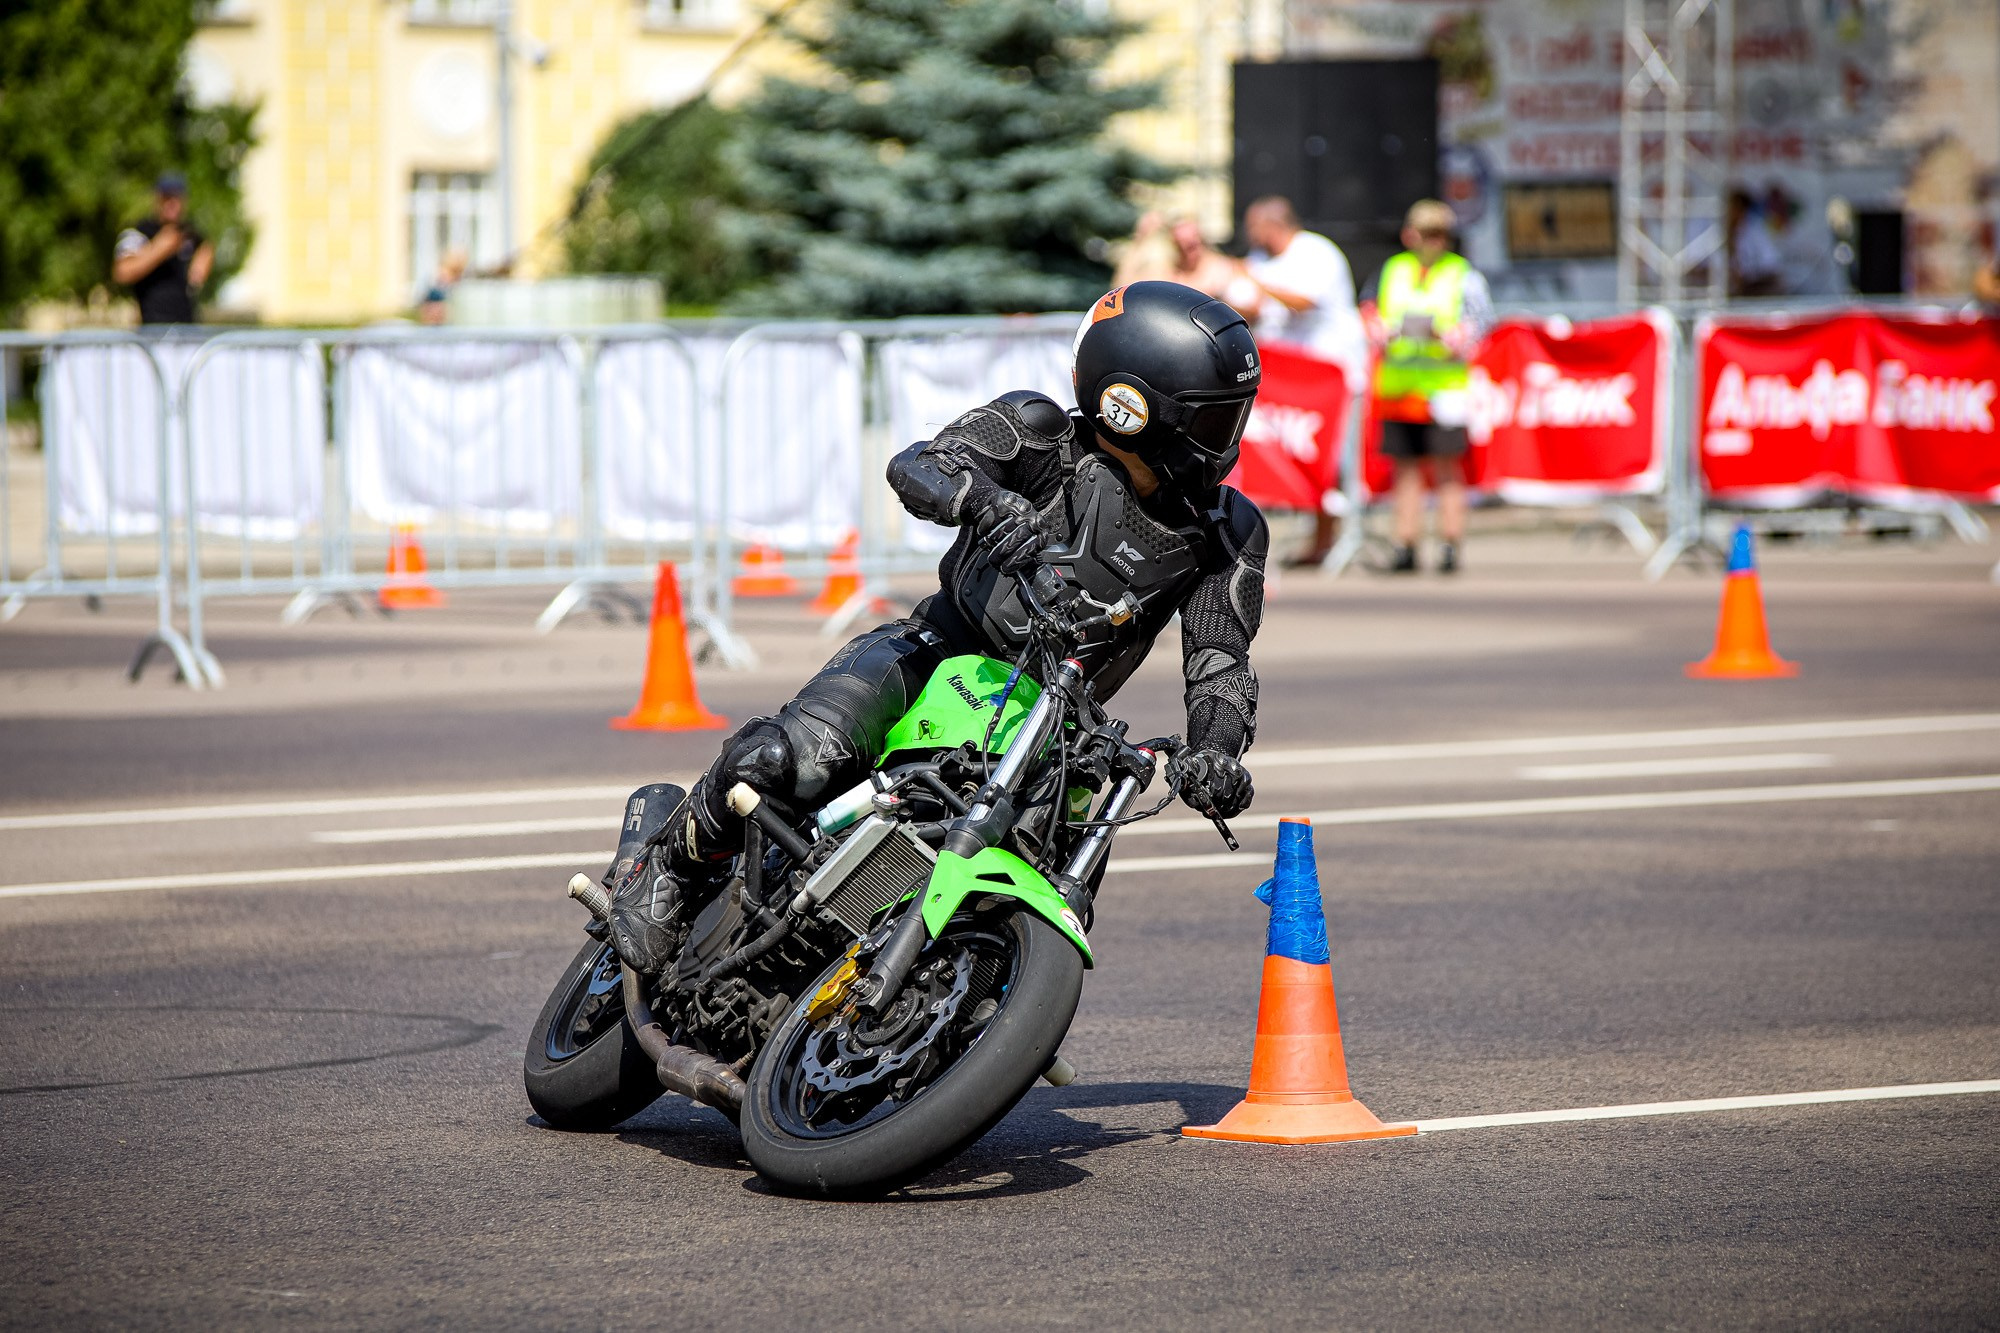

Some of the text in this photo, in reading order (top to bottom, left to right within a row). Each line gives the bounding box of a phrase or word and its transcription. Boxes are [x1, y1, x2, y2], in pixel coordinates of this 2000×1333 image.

[1236, 364, 1260, 382] SHAR
[1706, 359, 1997, 441] Альфа Банк
[1110, 554, 1135, 577] MOTEQ
[946, 673, 988, 711] Kawasaki
